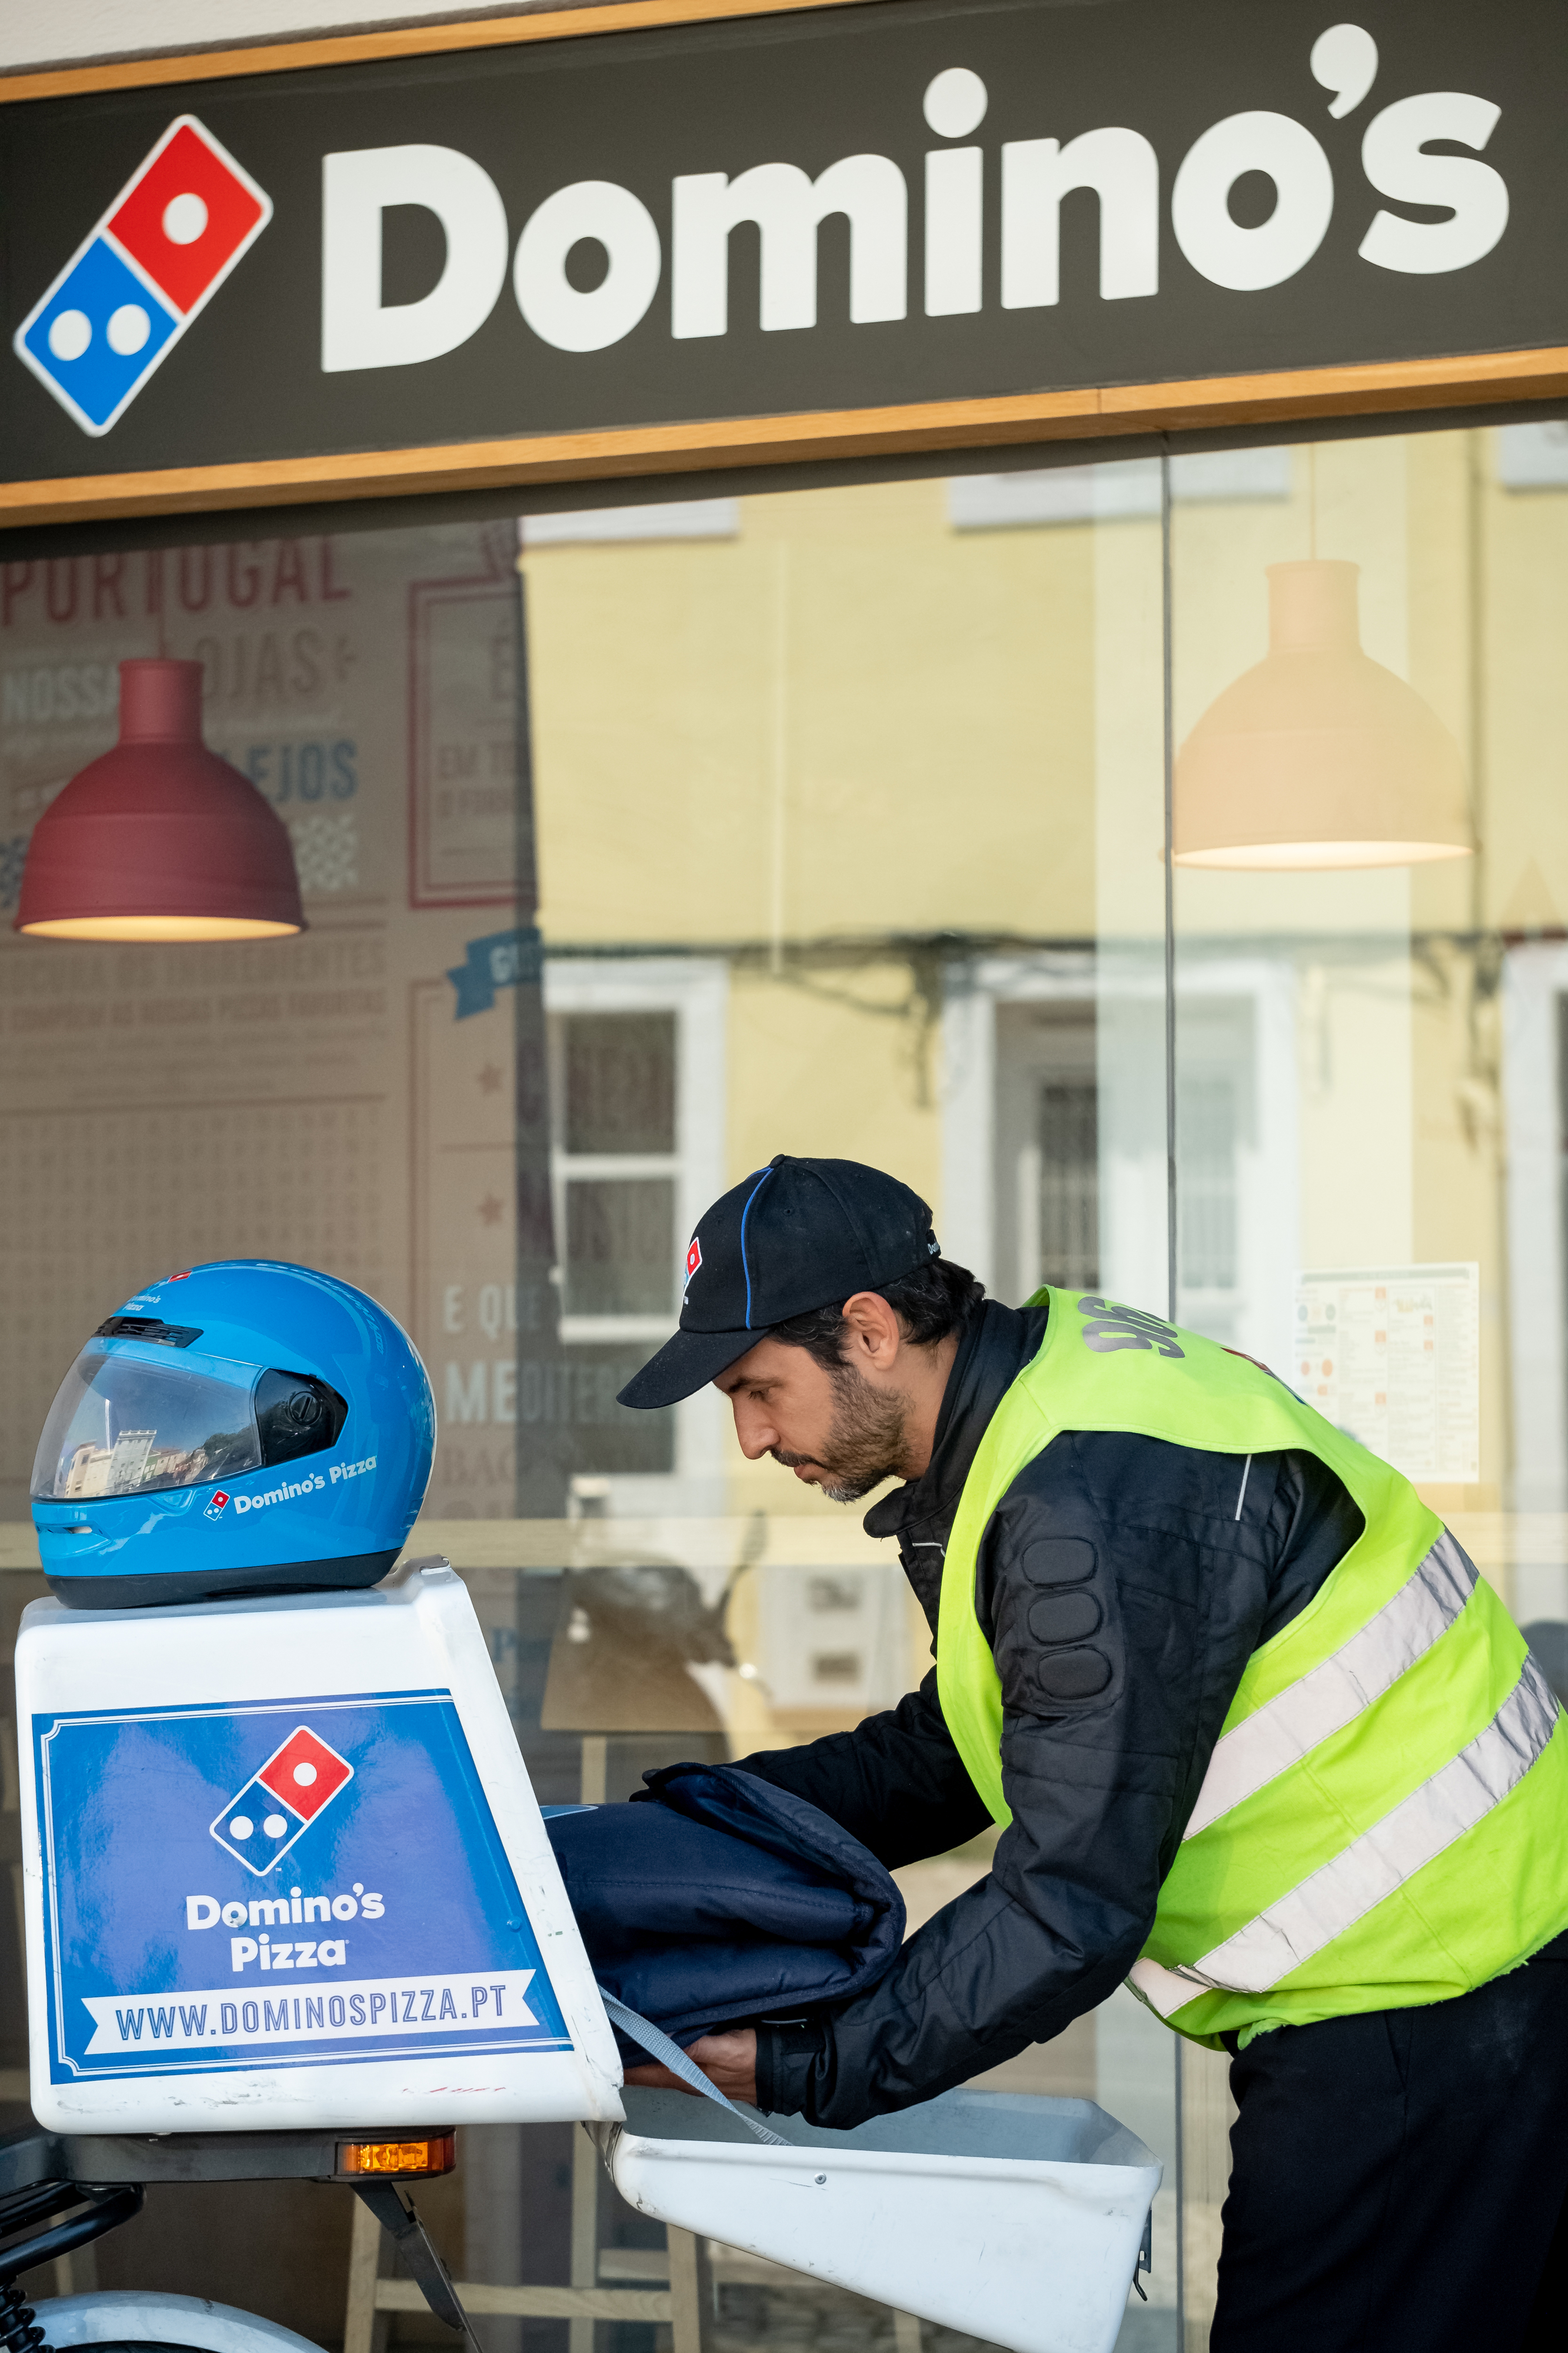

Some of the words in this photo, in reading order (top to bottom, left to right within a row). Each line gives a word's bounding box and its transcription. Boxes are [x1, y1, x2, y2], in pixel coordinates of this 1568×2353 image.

[321, 24, 1510, 374] Domino's
[233, 1472, 326, 1515] Domino's
[328, 1455, 377, 1484] Pizza
[186, 1882, 386, 1930] Domino's
[231, 1933, 347, 1972] Pizza
[114, 1984, 507, 2042] WWW.DOMINOSPIZZA.PT
